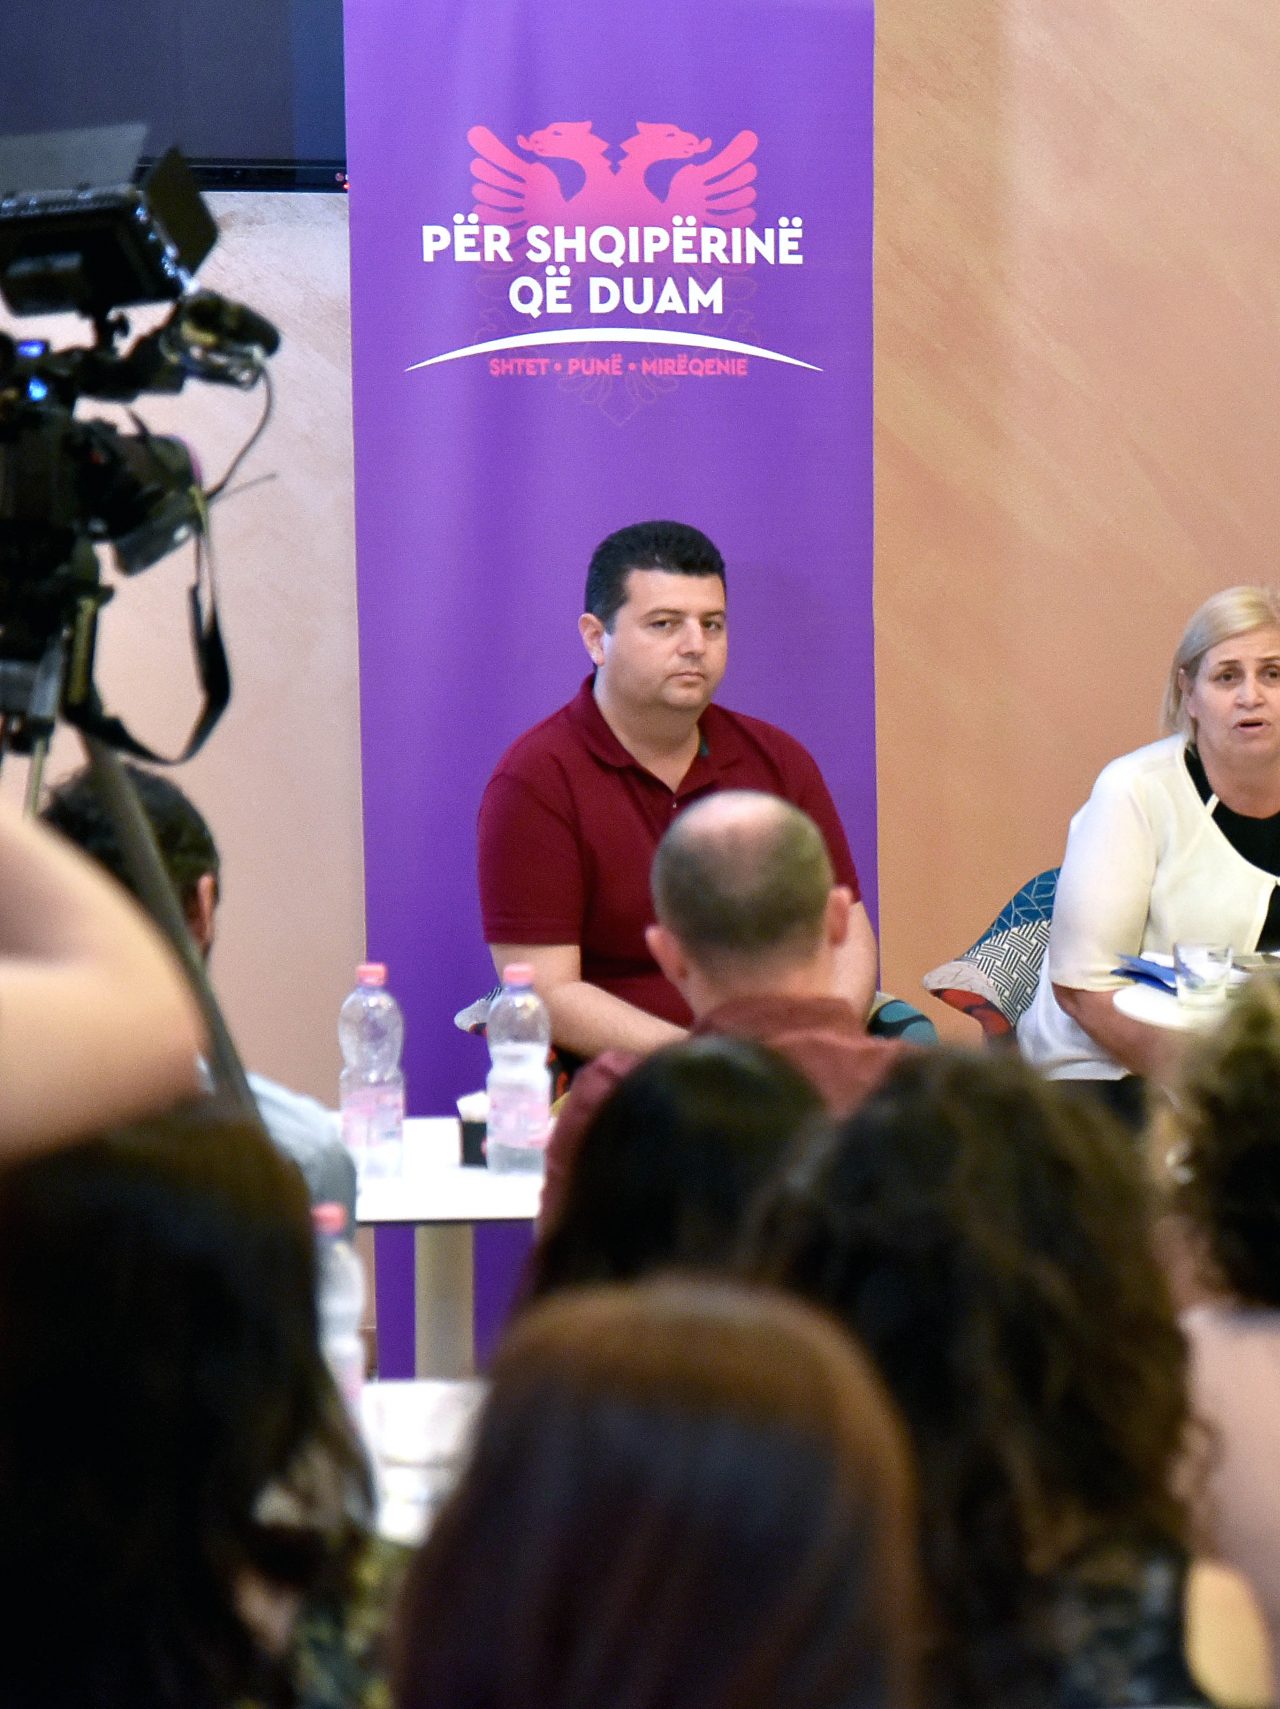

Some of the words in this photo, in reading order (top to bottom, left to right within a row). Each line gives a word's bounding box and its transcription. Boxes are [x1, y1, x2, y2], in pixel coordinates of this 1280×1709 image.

[422, 213, 513, 262] PËR
[526, 215, 804, 268] SHQIPËRINË
[509, 265, 572, 318] QË
[589, 277, 724, 314] DUAM
[489, 358, 549, 376] SHTET
[568, 353, 623, 376] PUNË
